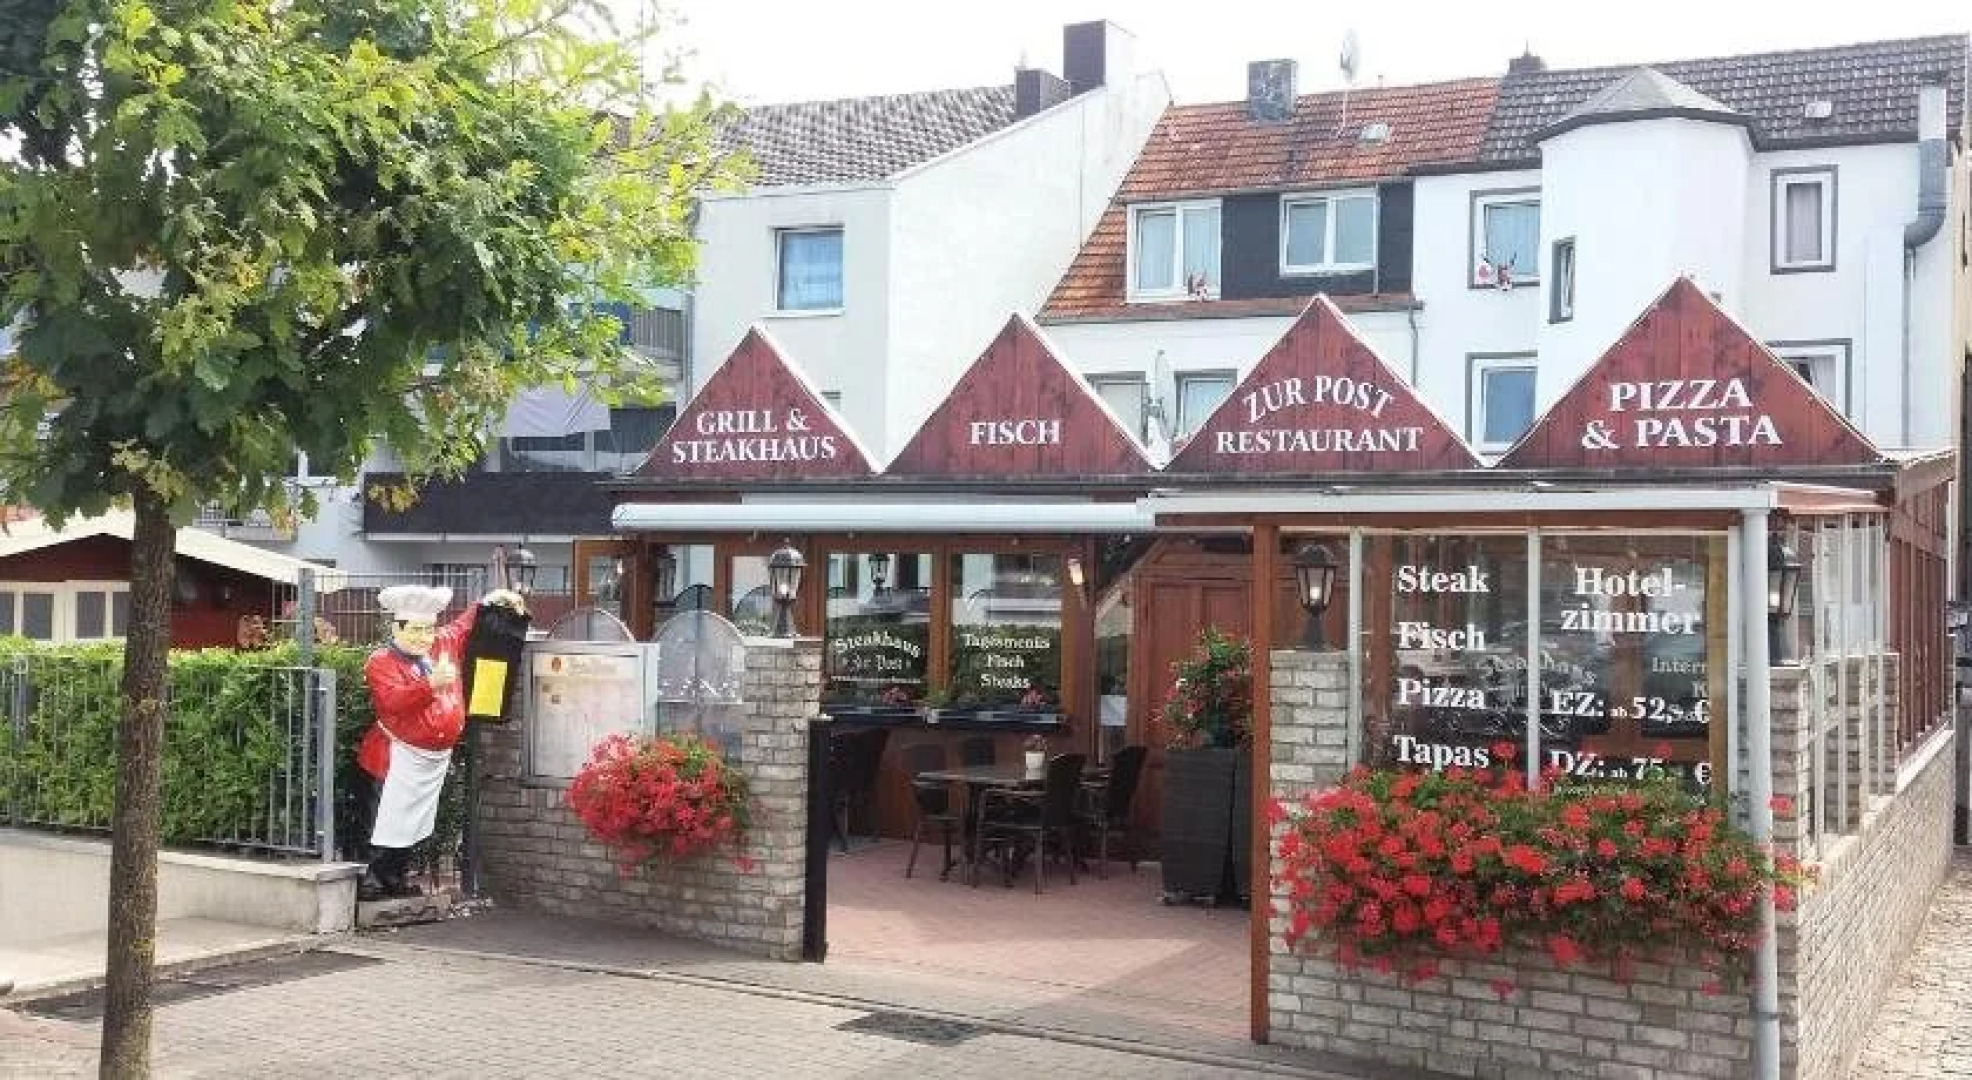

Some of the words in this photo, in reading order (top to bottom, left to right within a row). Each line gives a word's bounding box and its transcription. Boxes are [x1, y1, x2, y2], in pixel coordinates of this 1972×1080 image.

[1242, 376, 1304, 424] ZUR
[1314, 375, 1394, 420] POST
[1610, 378, 1752, 413] PIZZA
[696, 409, 778, 433] GRILL
[786, 408, 811, 431] &
[970, 419, 1060, 444] FISCH
[1580, 422, 1619, 450] &
[1637, 413, 1783, 449] PASTA
[671, 436, 836, 463] STEAKHAUS
[1215, 426, 1424, 454] RESTAURANT
[1398, 565, 1489, 594] Steak
[1574, 566, 1686, 598] Hotel-
[1560, 603, 1701, 636] zimmer
[834, 631, 920, 658] Steakhaus
[1398, 621, 1486, 651] Fisch
[985, 653, 1025, 668] Fisch
[981, 673, 1032, 689] Steaks
[1398, 677, 1486, 710] Pizza
[1551, 690, 1604, 717] EZ:
[1610, 706, 1627, 718] ab
[1393, 735, 1489, 771] Tapas
[1549, 748, 1604, 778] DZ:
[1610, 767, 1627, 778] ab
[1694, 762, 1711, 785] €
